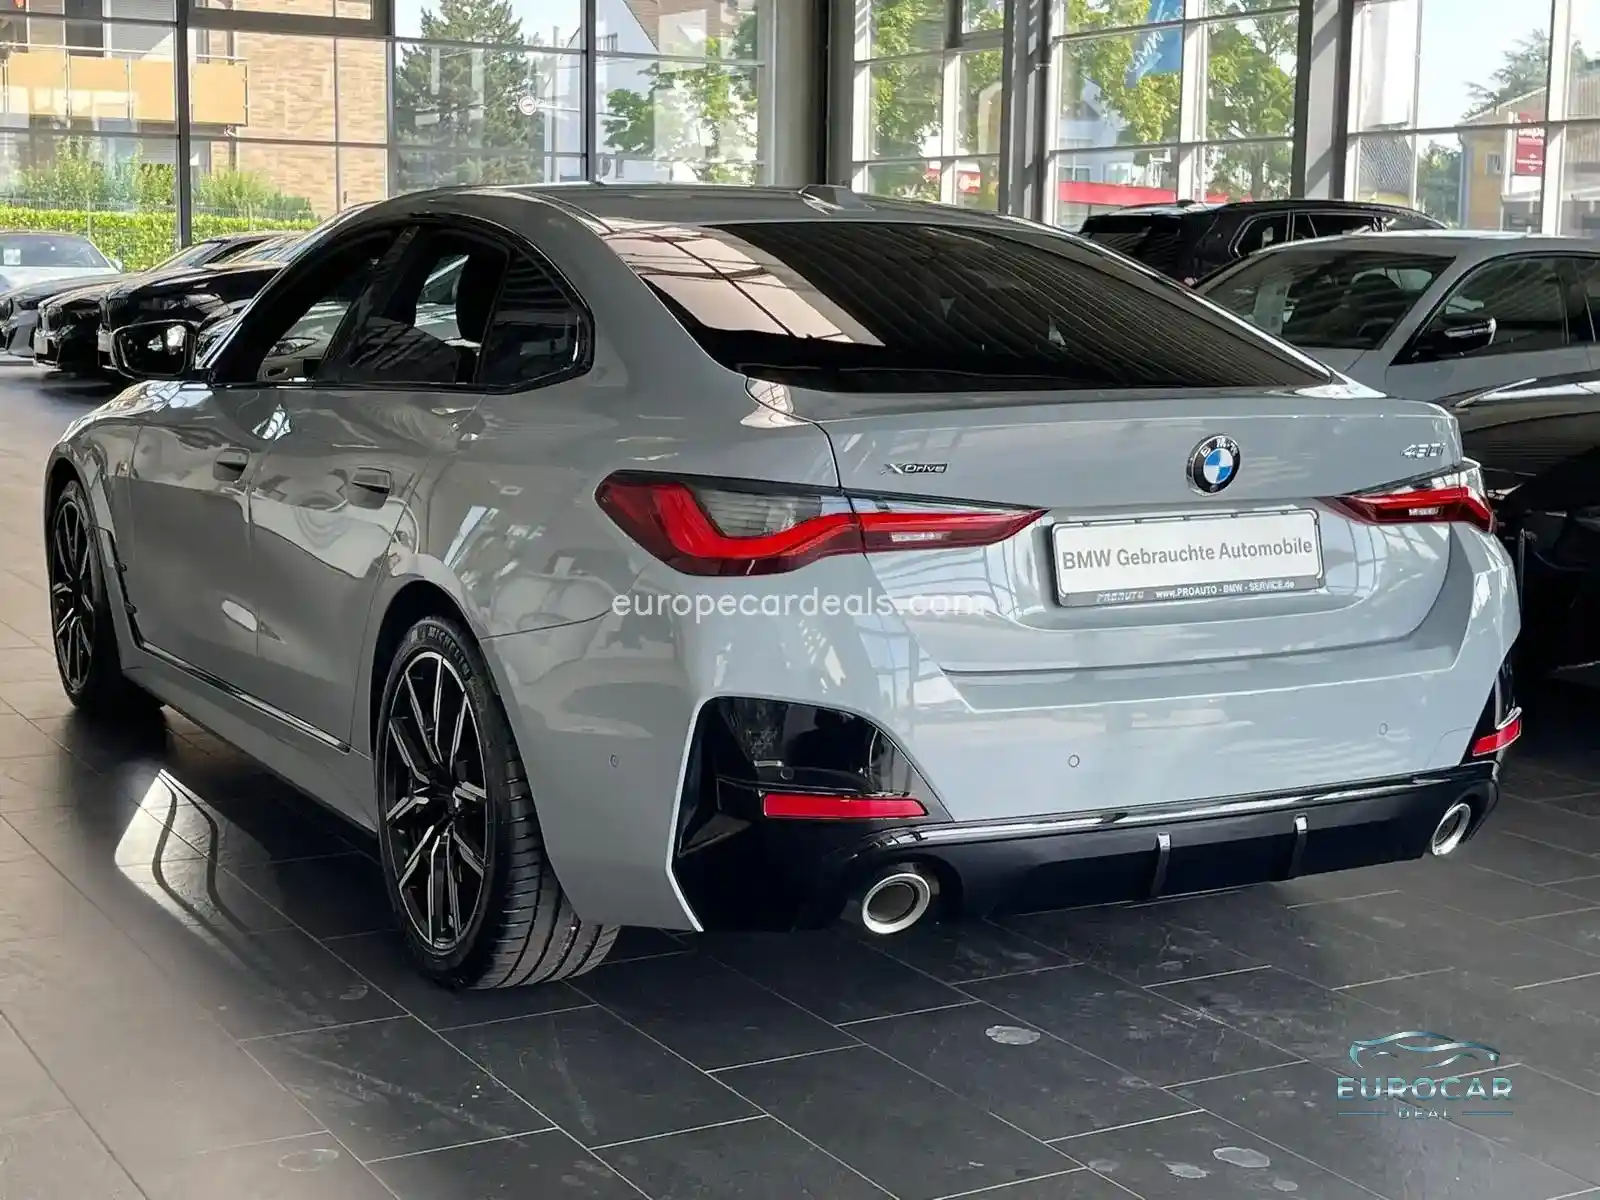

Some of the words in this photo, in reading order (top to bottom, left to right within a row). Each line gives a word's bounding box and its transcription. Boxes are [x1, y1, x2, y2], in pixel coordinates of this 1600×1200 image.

[1400, 442, 1447, 458] 430i
[1062, 548, 1112, 570] BMW
[1116, 543, 1216, 567] Gebrauchte
[1219, 537, 1313, 560] Automobile
